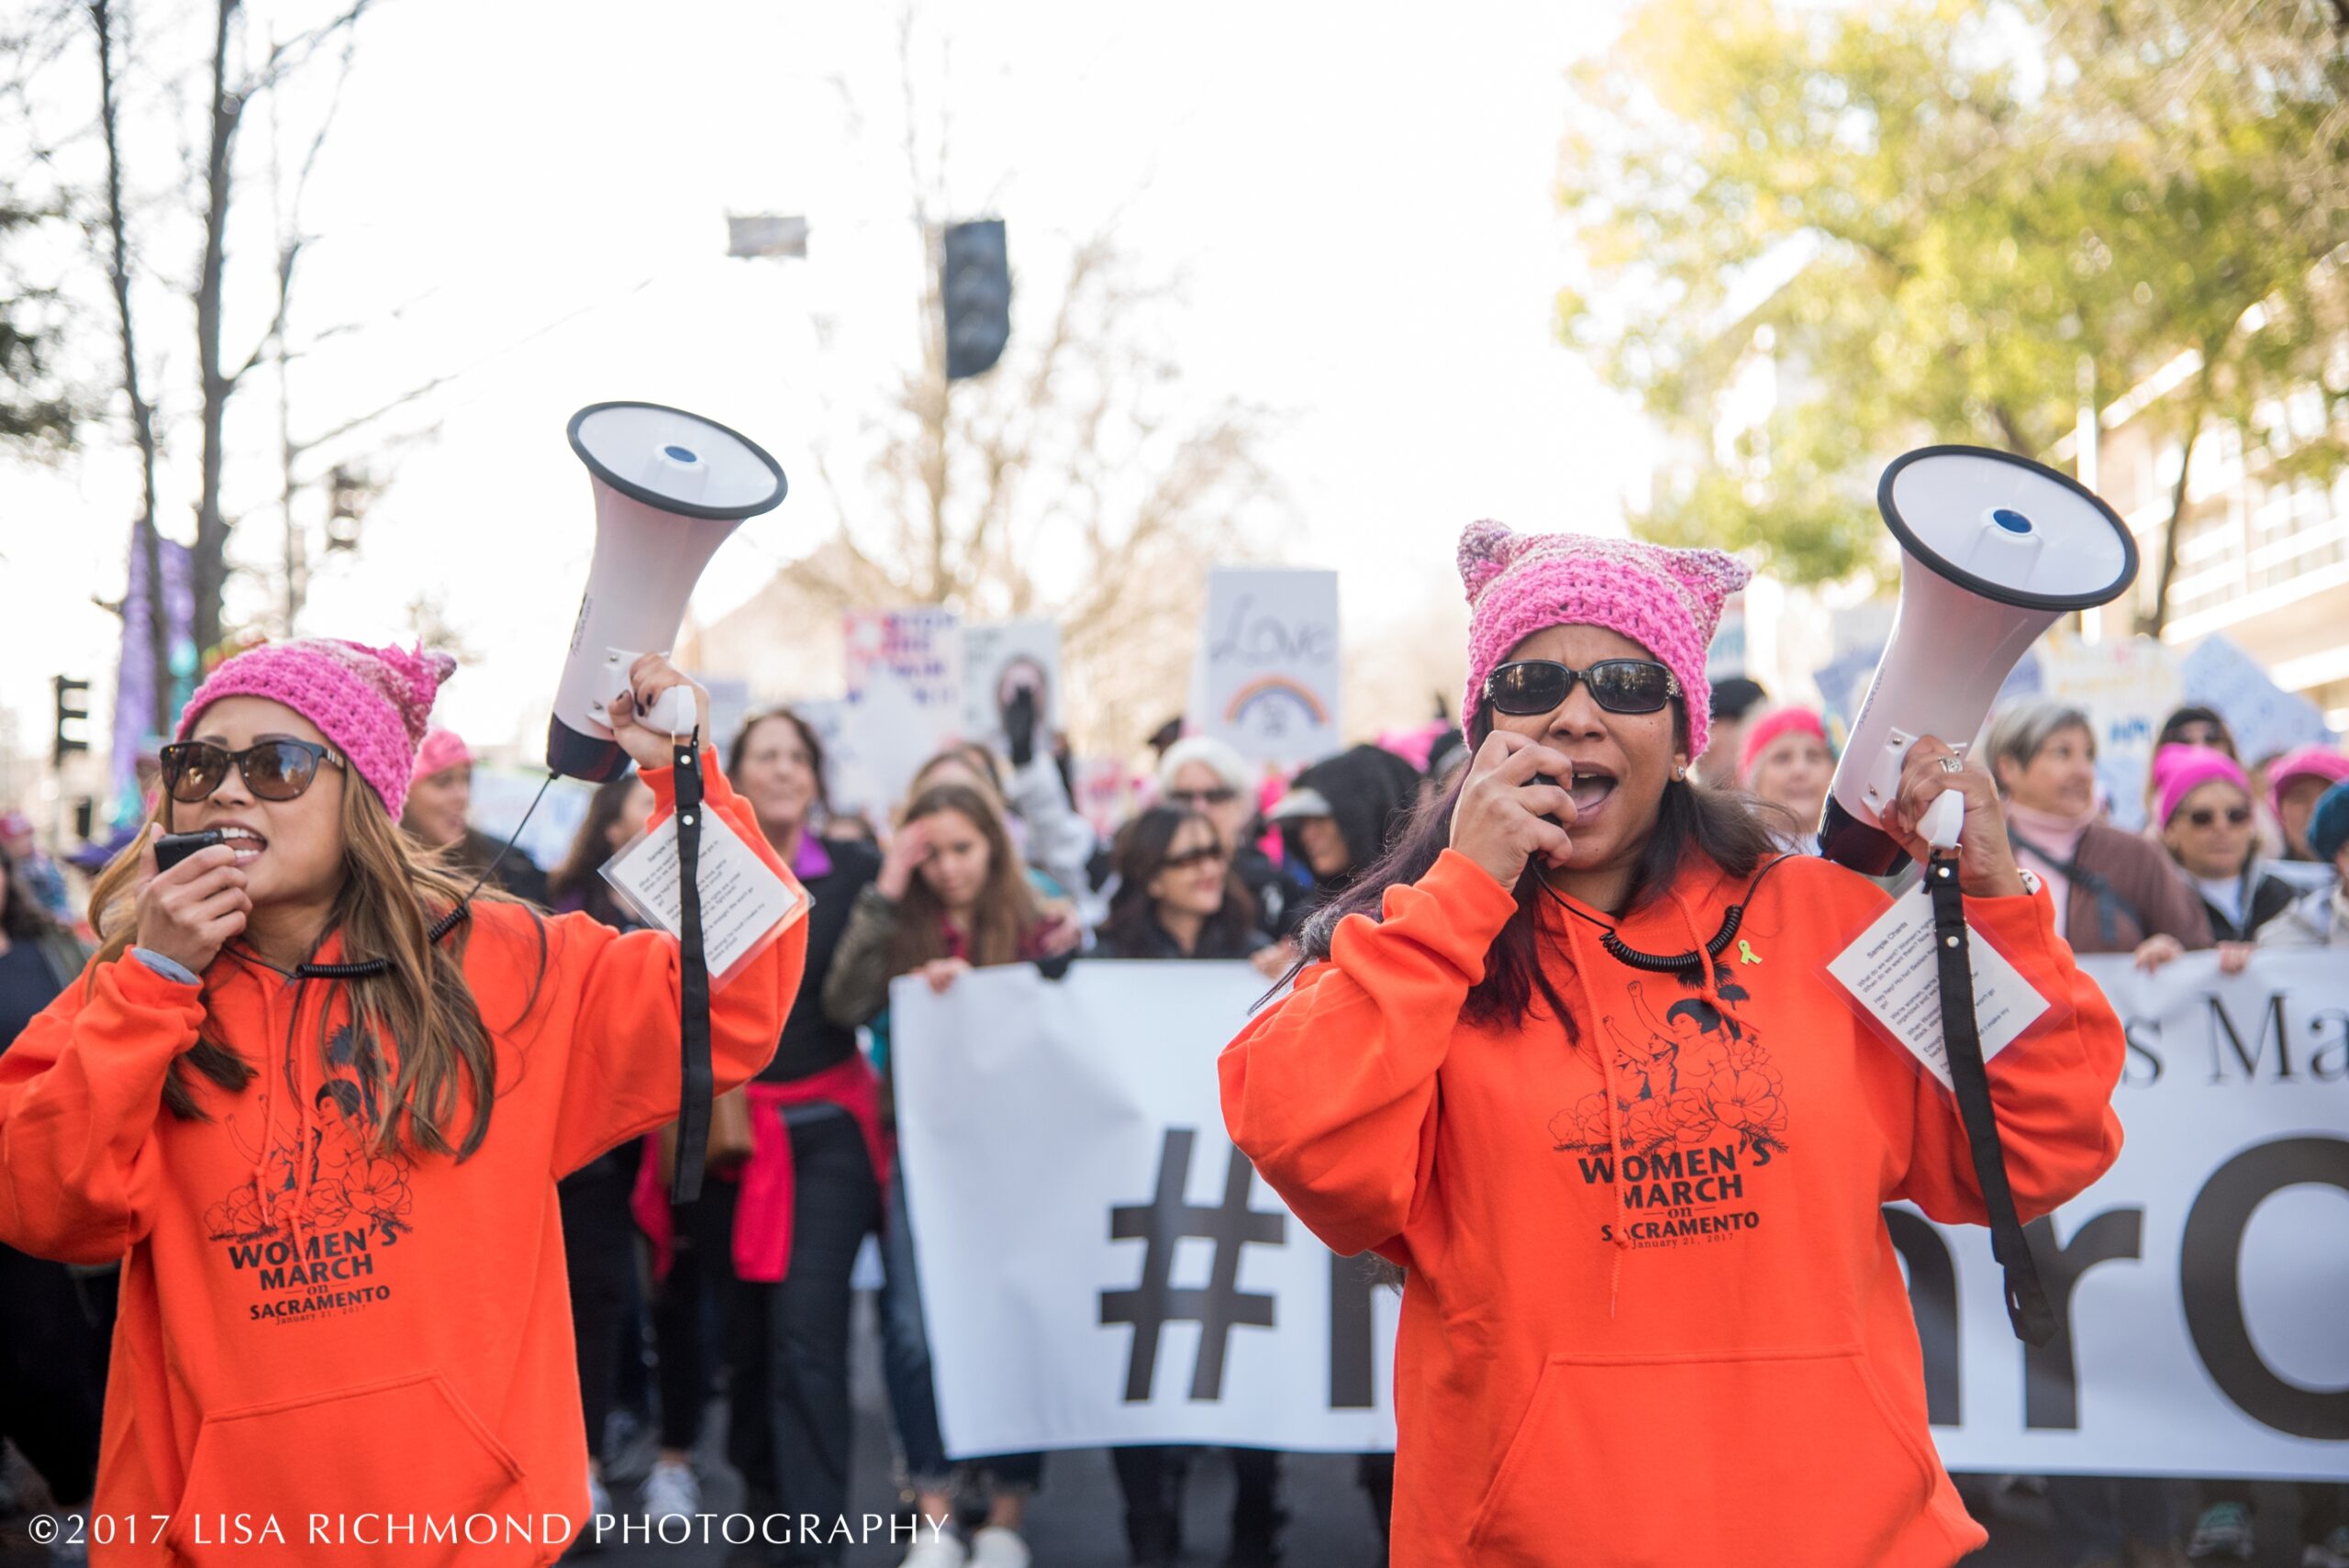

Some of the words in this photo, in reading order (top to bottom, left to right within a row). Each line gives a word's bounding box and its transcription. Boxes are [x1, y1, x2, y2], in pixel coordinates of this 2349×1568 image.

[1867, 939, 1888, 959] Sample
[1887, 921, 1908, 940] Chants
[1857, 974, 1871, 988] What
[1863, 979, 1877, 993] When
[1578, 1142, 1771, 1184] WOMEN'S
[1667, 1207, 1693, 1218] on
[228, 1223, 397, 1270] WOMEN'S
[1631, 1239, 1678, 1250] January
[1707, 1232, 1734, 1243] 2017
[260, 1253, 373, 1291] MARCH
[306, 1284, 328, 1296] on
[250, 1284, 391, 1320] SACRAMENTO
[275, 1312, 317, 1326] January
